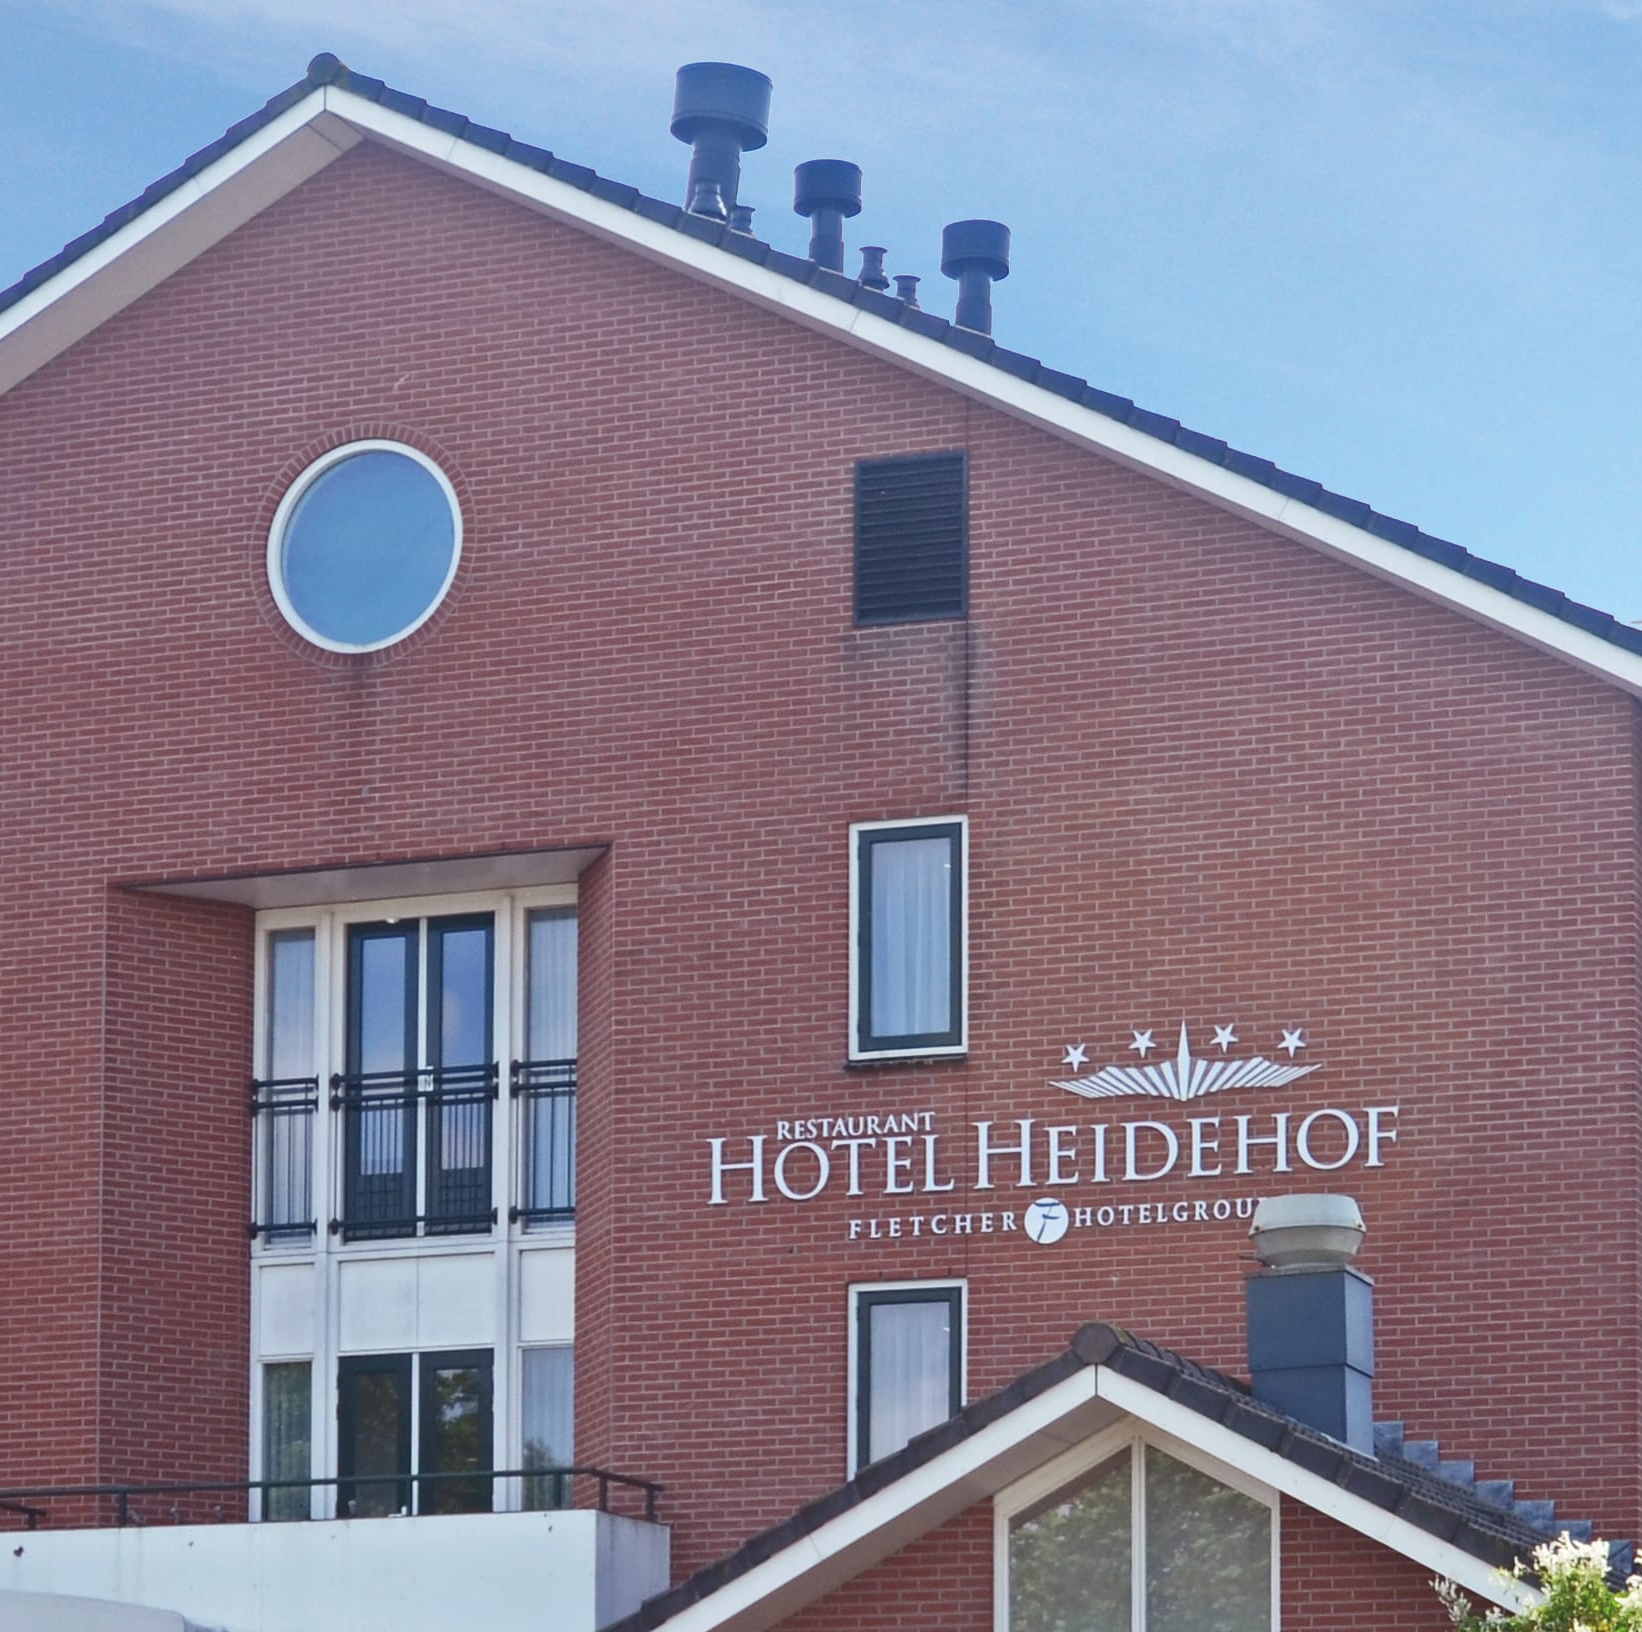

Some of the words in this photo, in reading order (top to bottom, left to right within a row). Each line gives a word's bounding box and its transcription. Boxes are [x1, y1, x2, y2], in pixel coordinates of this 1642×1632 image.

[777, 1111, 936, 1140] RESTAURANT
[706, 1134, 955, 1205] HOTEL
[971, 1105, 1399, 1190] HEIDEHOF
[848, 1211, 1018, 1240] FLETCHER
